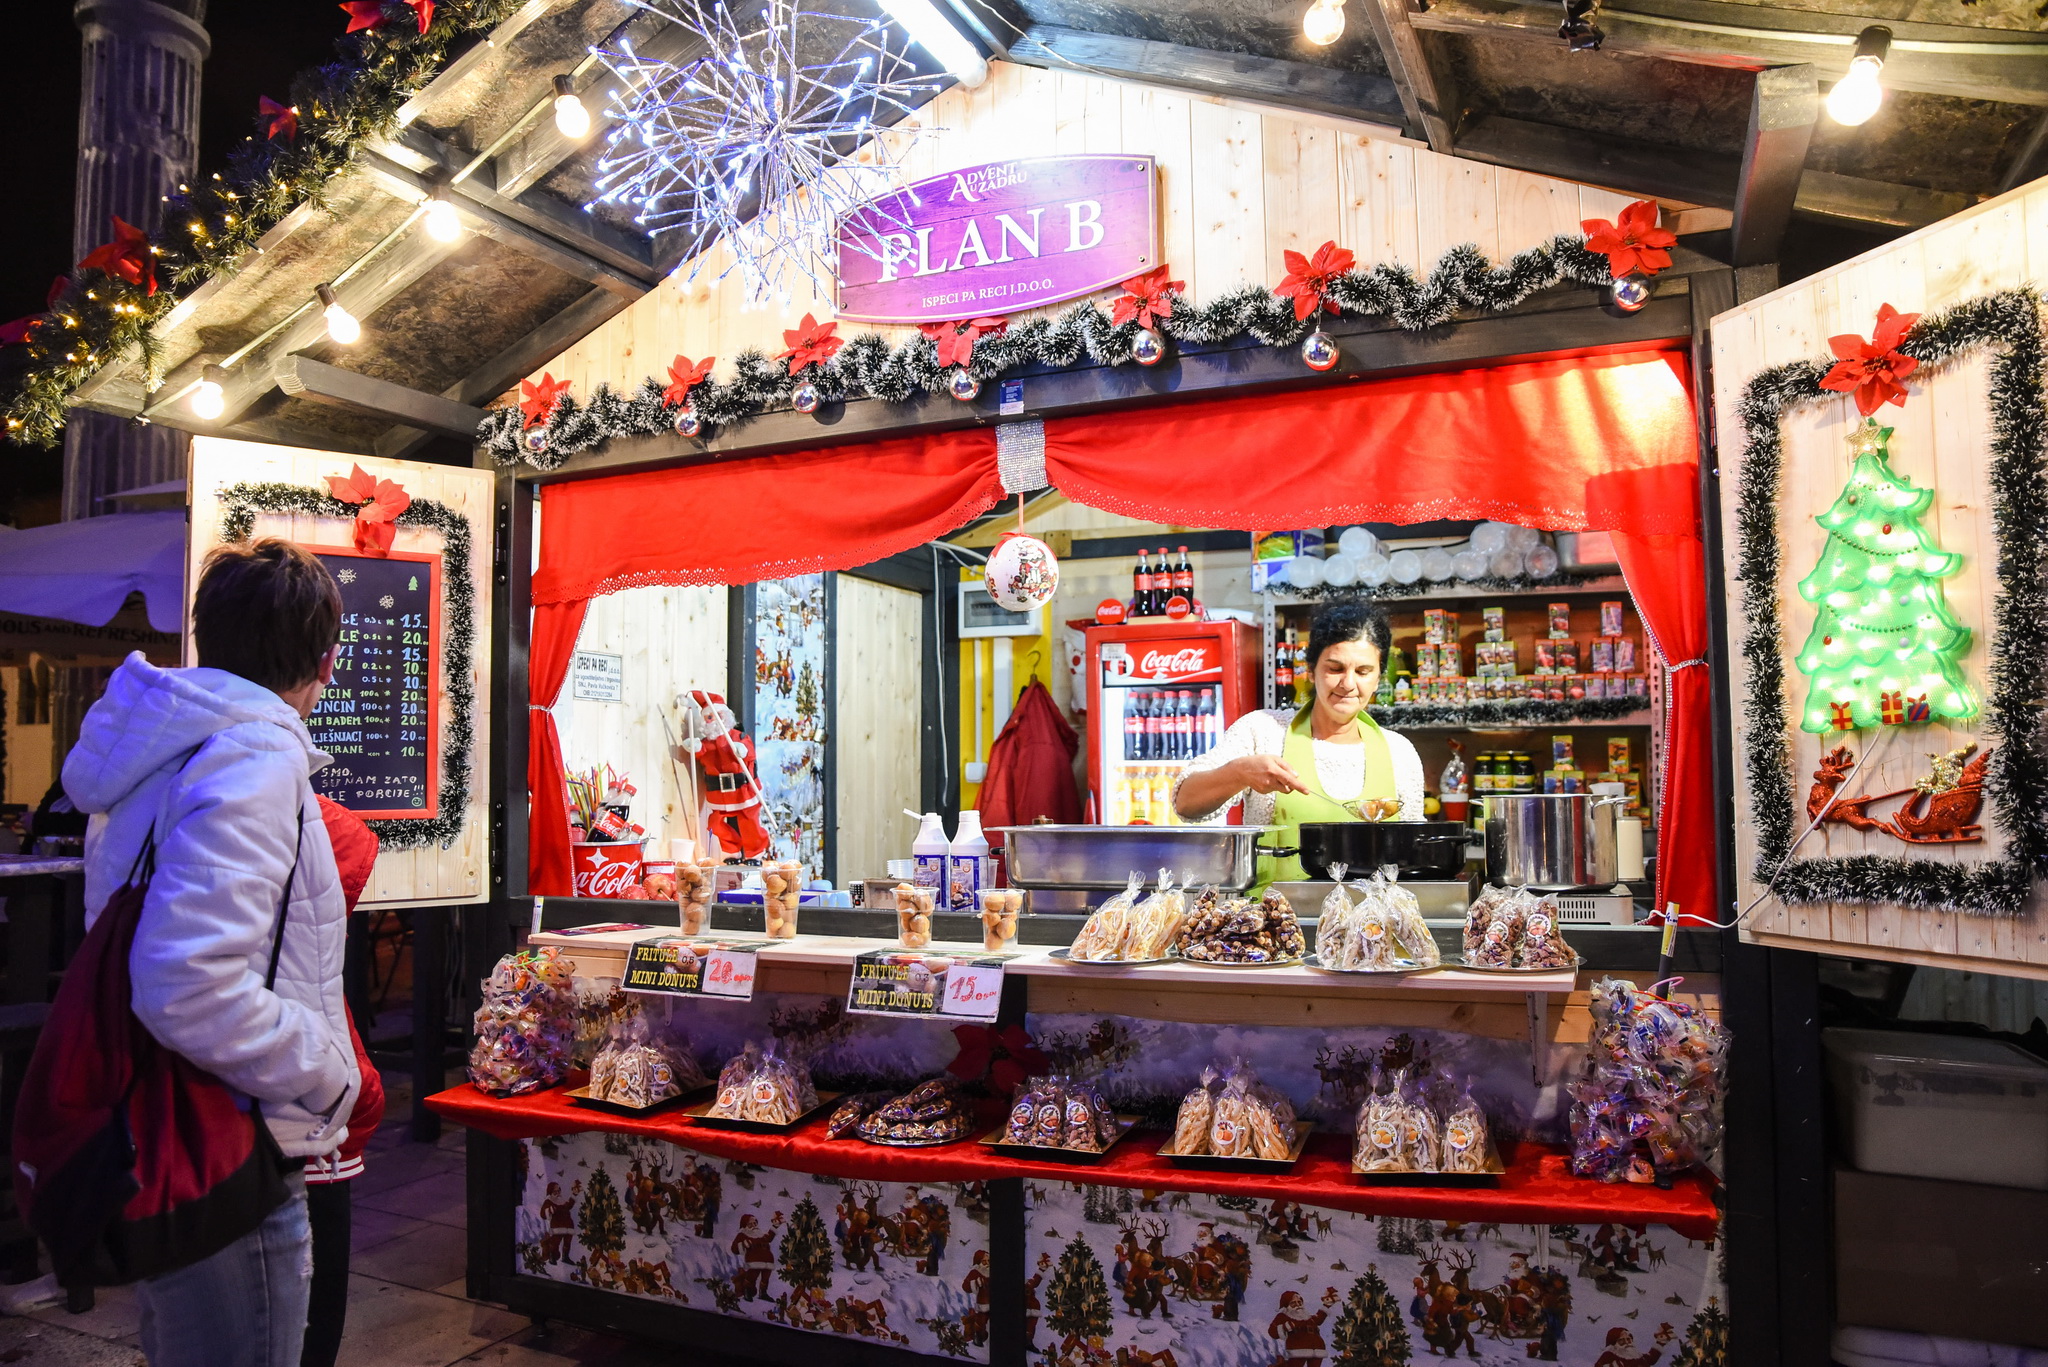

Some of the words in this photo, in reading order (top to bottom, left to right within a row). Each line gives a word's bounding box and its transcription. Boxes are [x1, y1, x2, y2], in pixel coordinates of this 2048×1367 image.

[948, 162, 1018, 202] ADVENT
[979, 171, 1027, 193] ZADRU
[877, 208, 1044, 284] PLAN
[1064, 200, 1105, 252] B
[922, 293, 958, 308] ISPECI
[962, 290, 976, 301] PA
[979, 285, 1007, 298] RECI
[1009, 279, 1055, 297] J.D.O.O.
[0, 619, 41, 634] OUS
[339, 629, 360, 643] LE
[334, 658, 353, 670] VI
[1141, 648, 1207, 673] Coca-Cola
[320, 688, 352, 699] NCIN
[311, 700, 356, 713] UNCIN
[305, 717, 323, 727] ENI
[326, 715, 362, 726] BADEM
[345, 776, 377, 786] NAM
[384, 776, 417, 785] ZATO
[635, 947, 679, 963] FRITULE
[681, 955, 695, 965] 0,5
[630, 970, 658, 985] MINI
[658, 972, 699, 988] DONUTS
[860, 964, 910, 981] FRITULE
[856, 989, 887, 1007] MINI
[888, 991, 934, 1009] DONUTS
